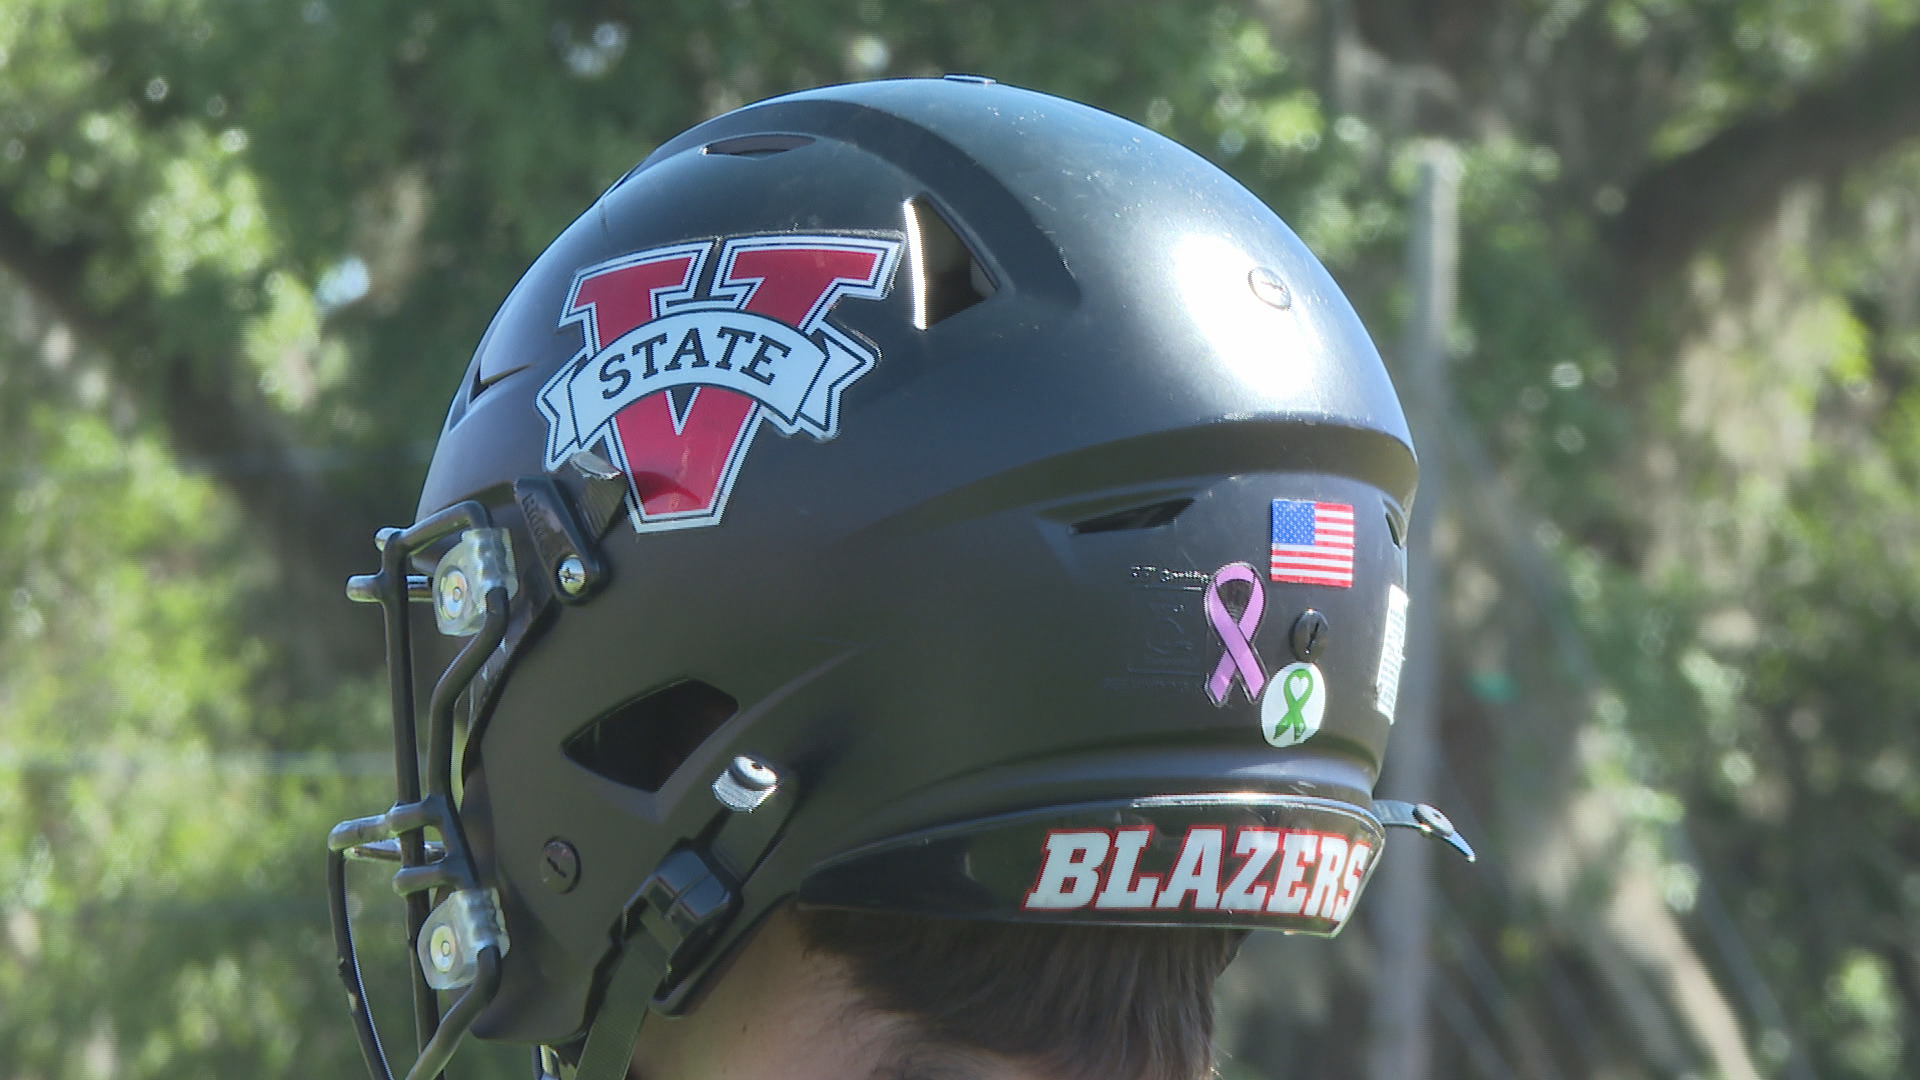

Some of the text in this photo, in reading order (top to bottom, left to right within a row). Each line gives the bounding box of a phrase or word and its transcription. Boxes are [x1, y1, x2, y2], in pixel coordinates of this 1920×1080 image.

[558, 236, 902, 533] V
[599, 326, 792, 400] STATE
[1021, 825, 1371, 922] BLAZERS
